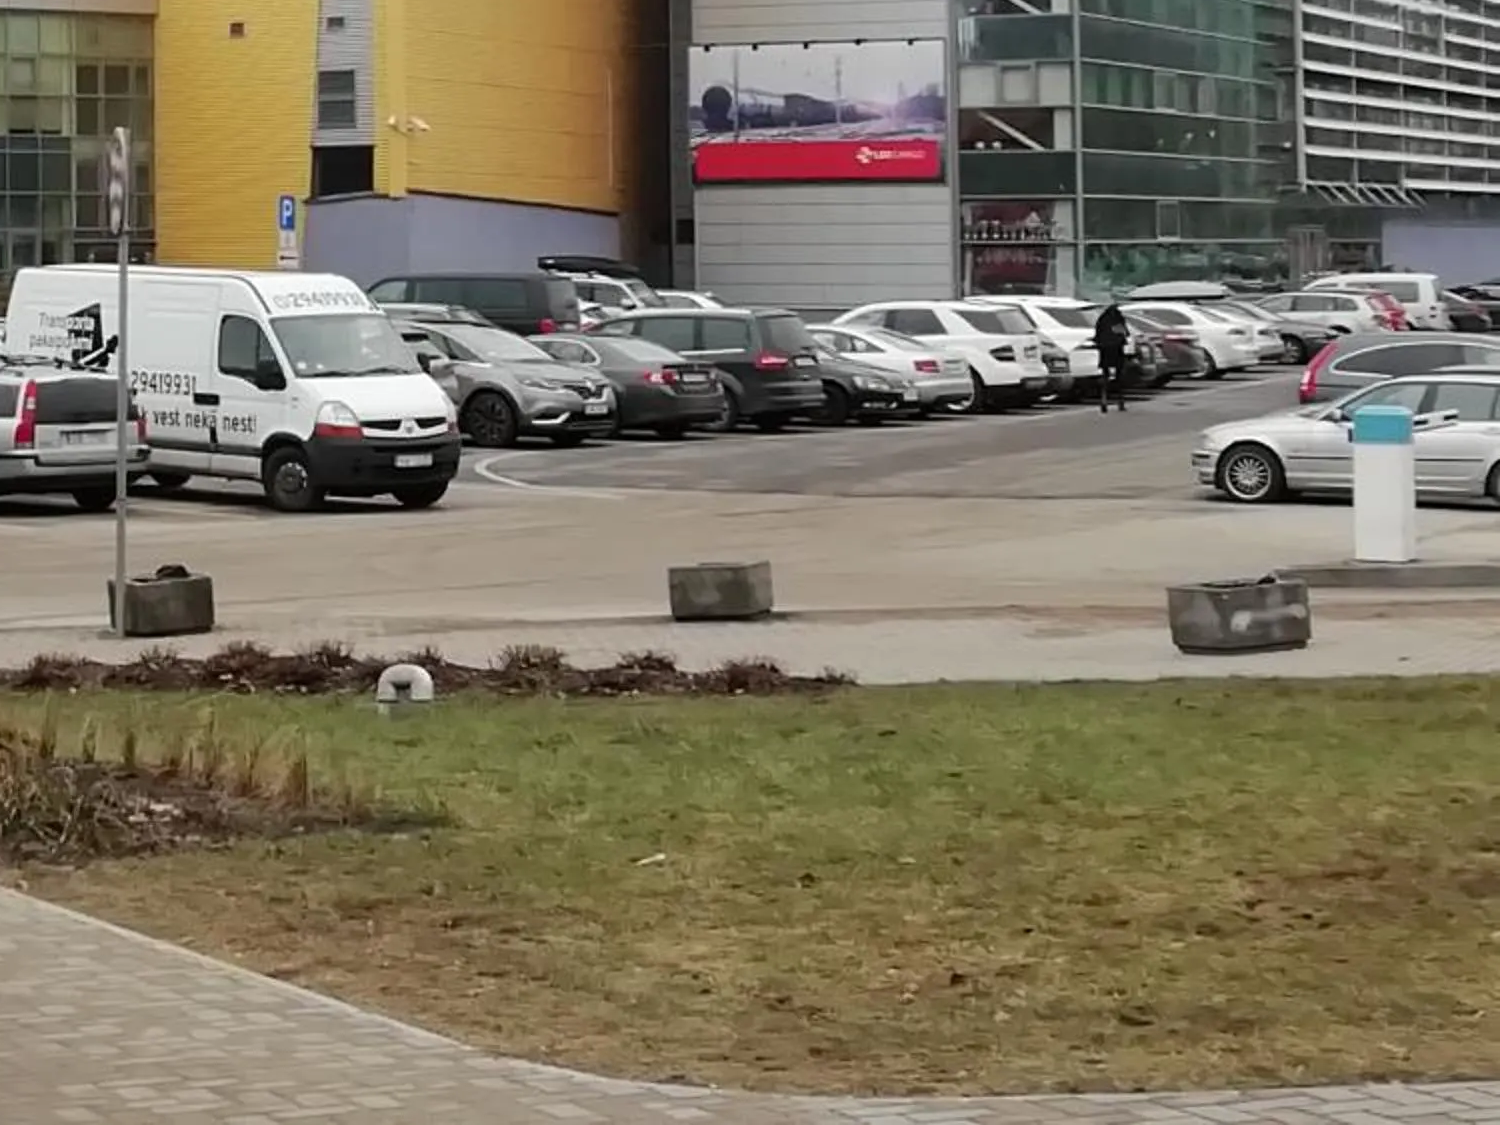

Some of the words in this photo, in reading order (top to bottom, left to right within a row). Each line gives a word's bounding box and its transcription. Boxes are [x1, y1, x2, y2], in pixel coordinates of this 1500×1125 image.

[281, 198, 293, 226] P
[131, 370, 197, 396] 29419931
[153, 408, 181, 427] vest
